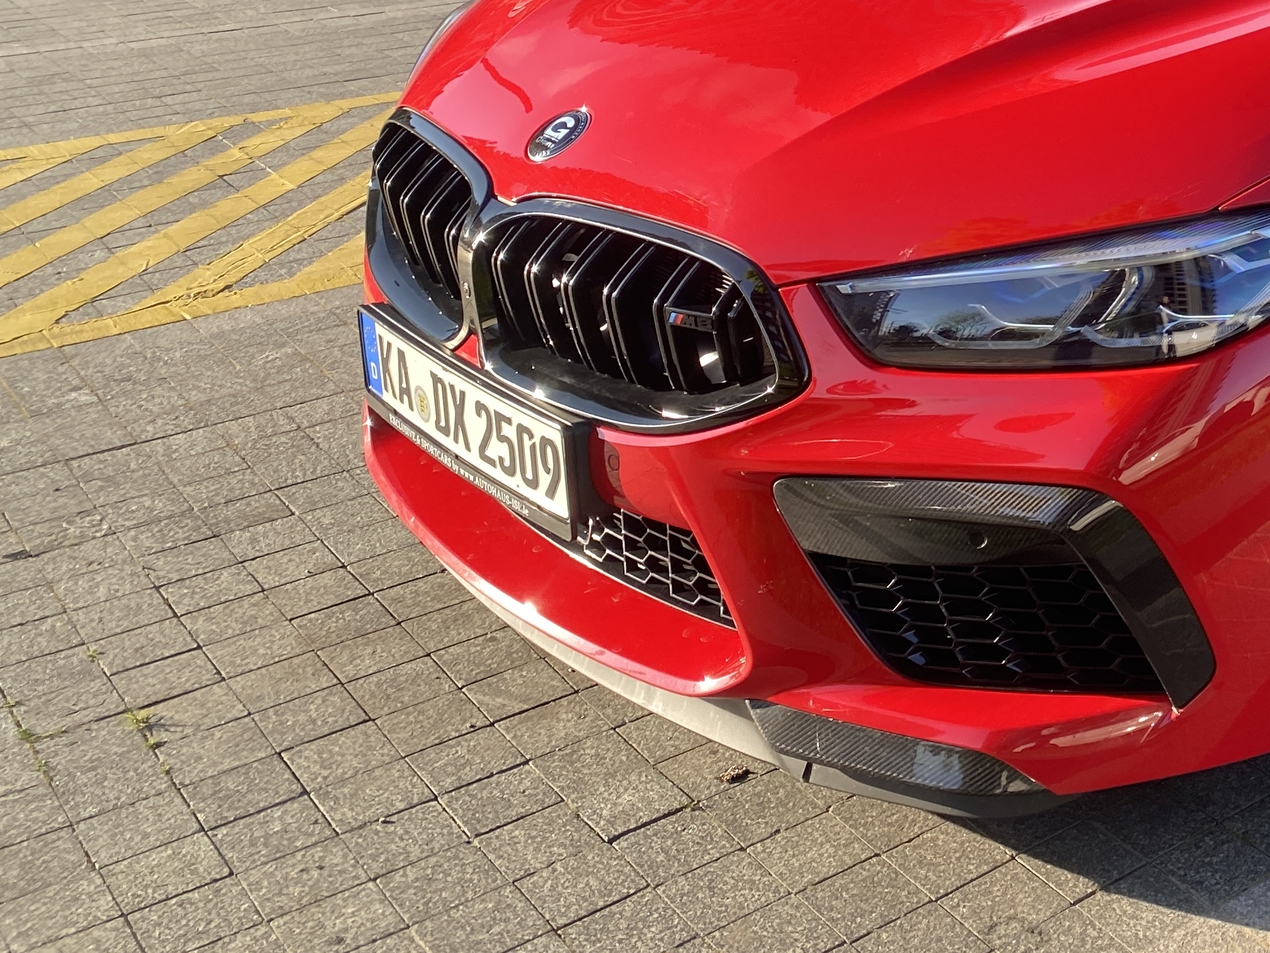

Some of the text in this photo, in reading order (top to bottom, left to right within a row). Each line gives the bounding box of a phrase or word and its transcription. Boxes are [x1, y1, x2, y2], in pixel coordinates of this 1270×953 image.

[371, 361, 378, 380] D
[378, 333, 562, 501] KA DX 2509
